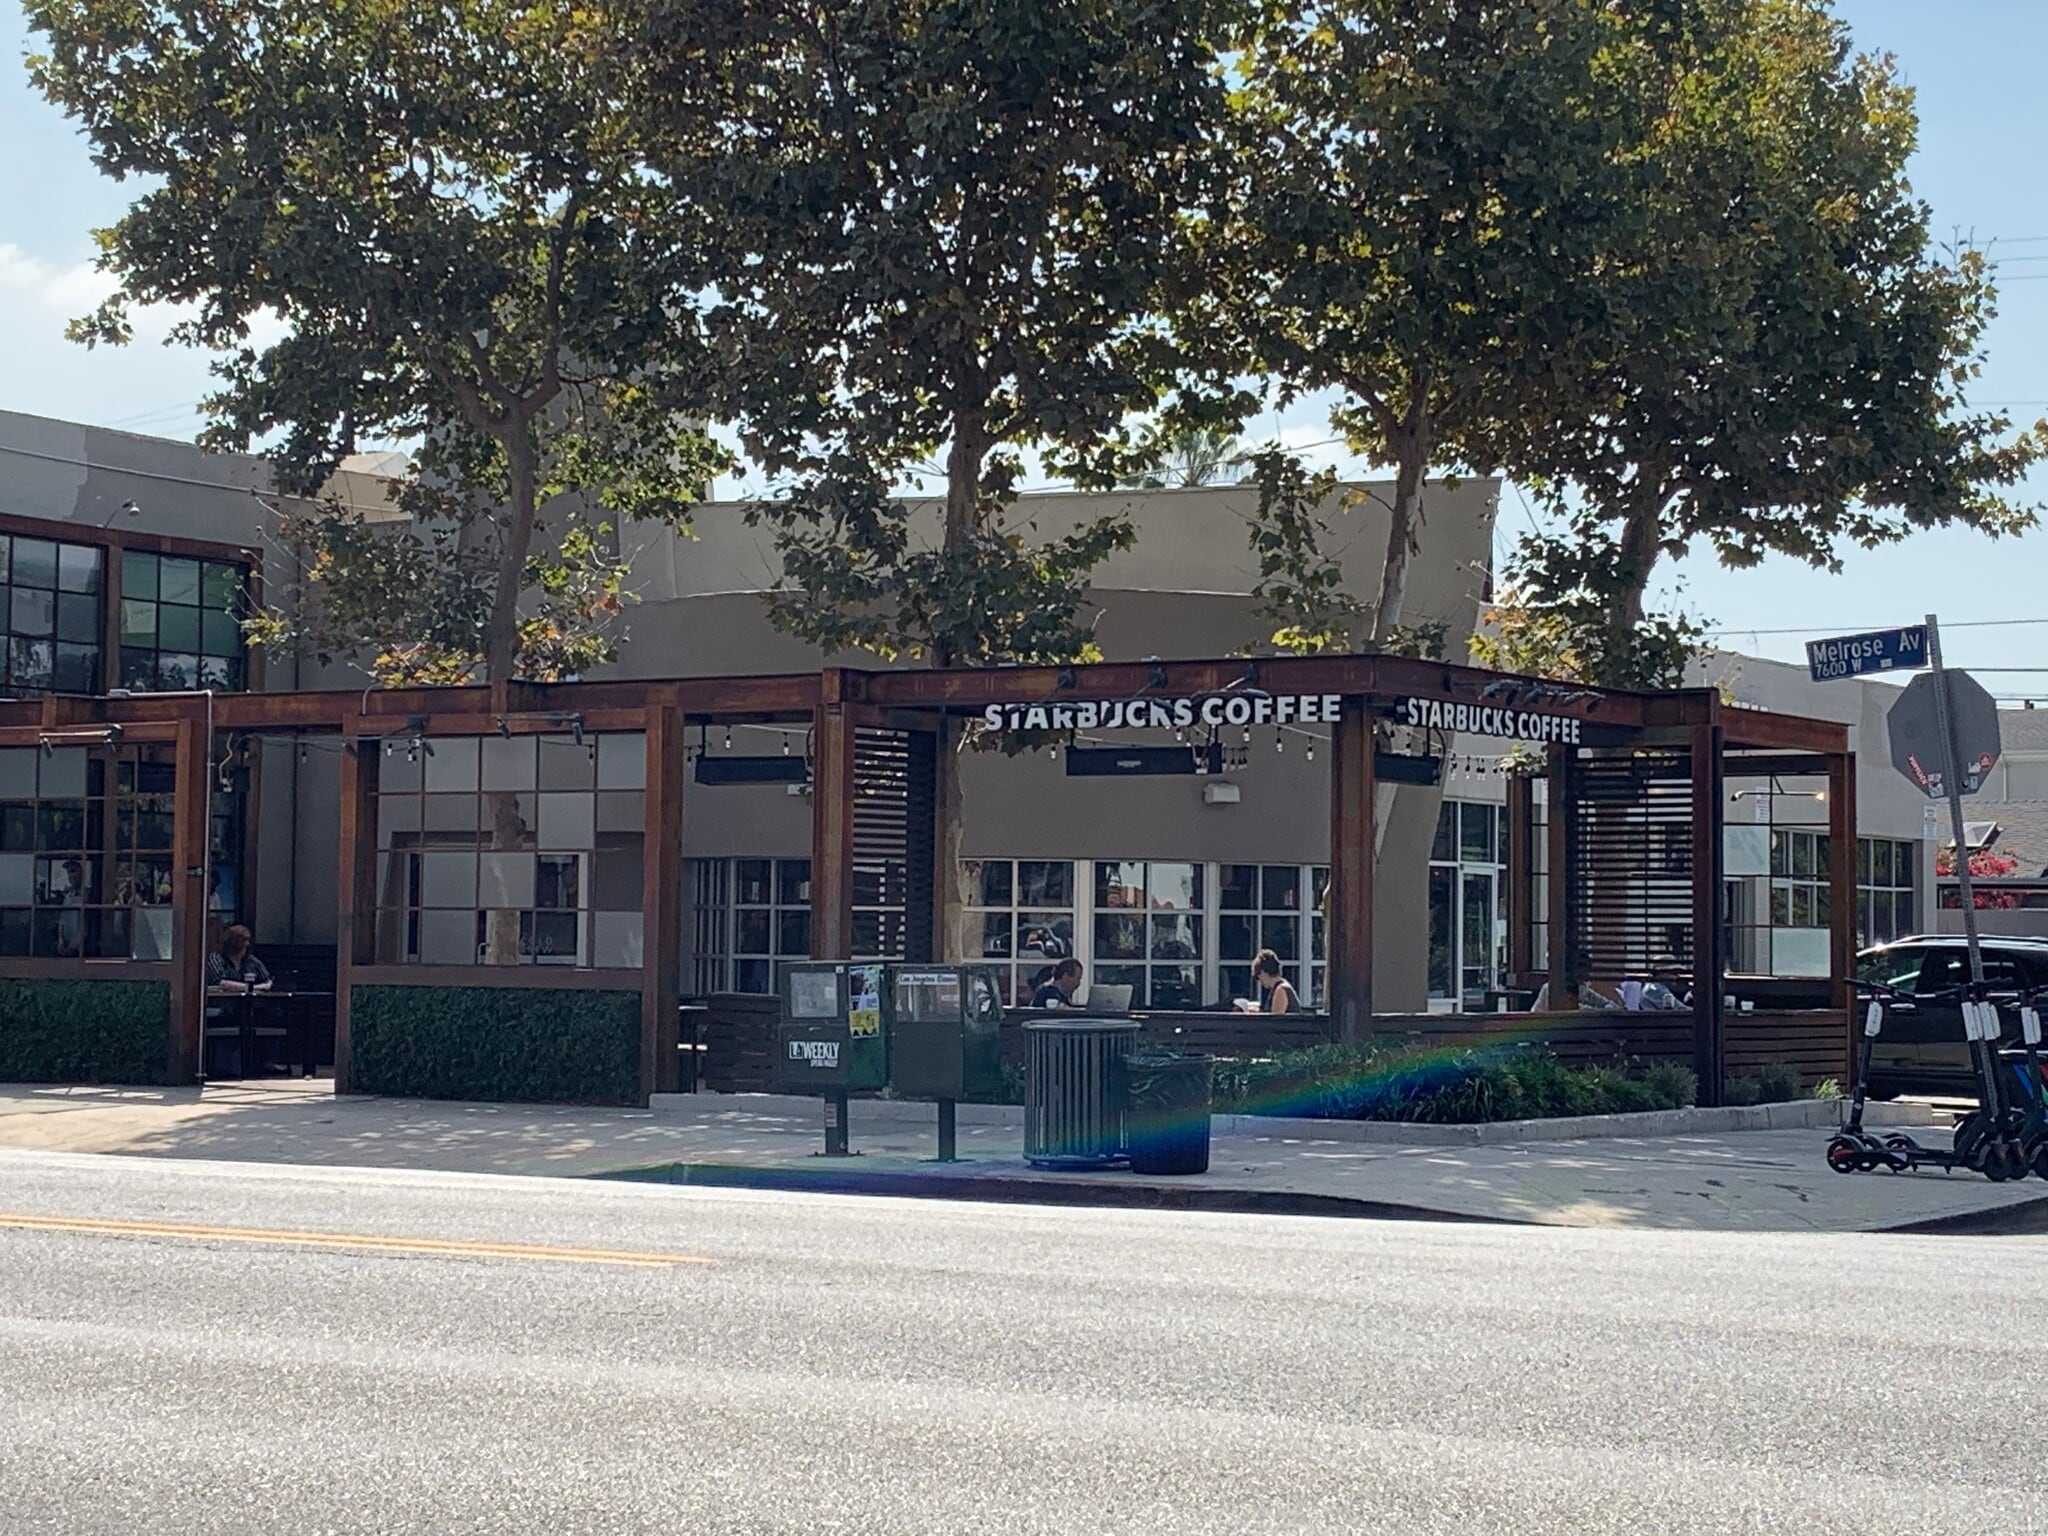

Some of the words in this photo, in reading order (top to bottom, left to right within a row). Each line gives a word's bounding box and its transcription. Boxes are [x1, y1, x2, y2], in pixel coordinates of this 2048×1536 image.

[1813, 639, 1883, 663] Melrose
[1899, 631, 1920, 652] Av
[1816, 660, 1847, 678] 7600
[1851, 658, 1862, 672] W
[984, 698, 1193, 731] STARBUCKS
[1202, 694, 1342, 725] COFFEE
[1407, 697, 1515, 737] STARBUCKS
[1518, 713, 1581, 744] COFFEE
[803, 1041, 840, 1059] WEEKLY
